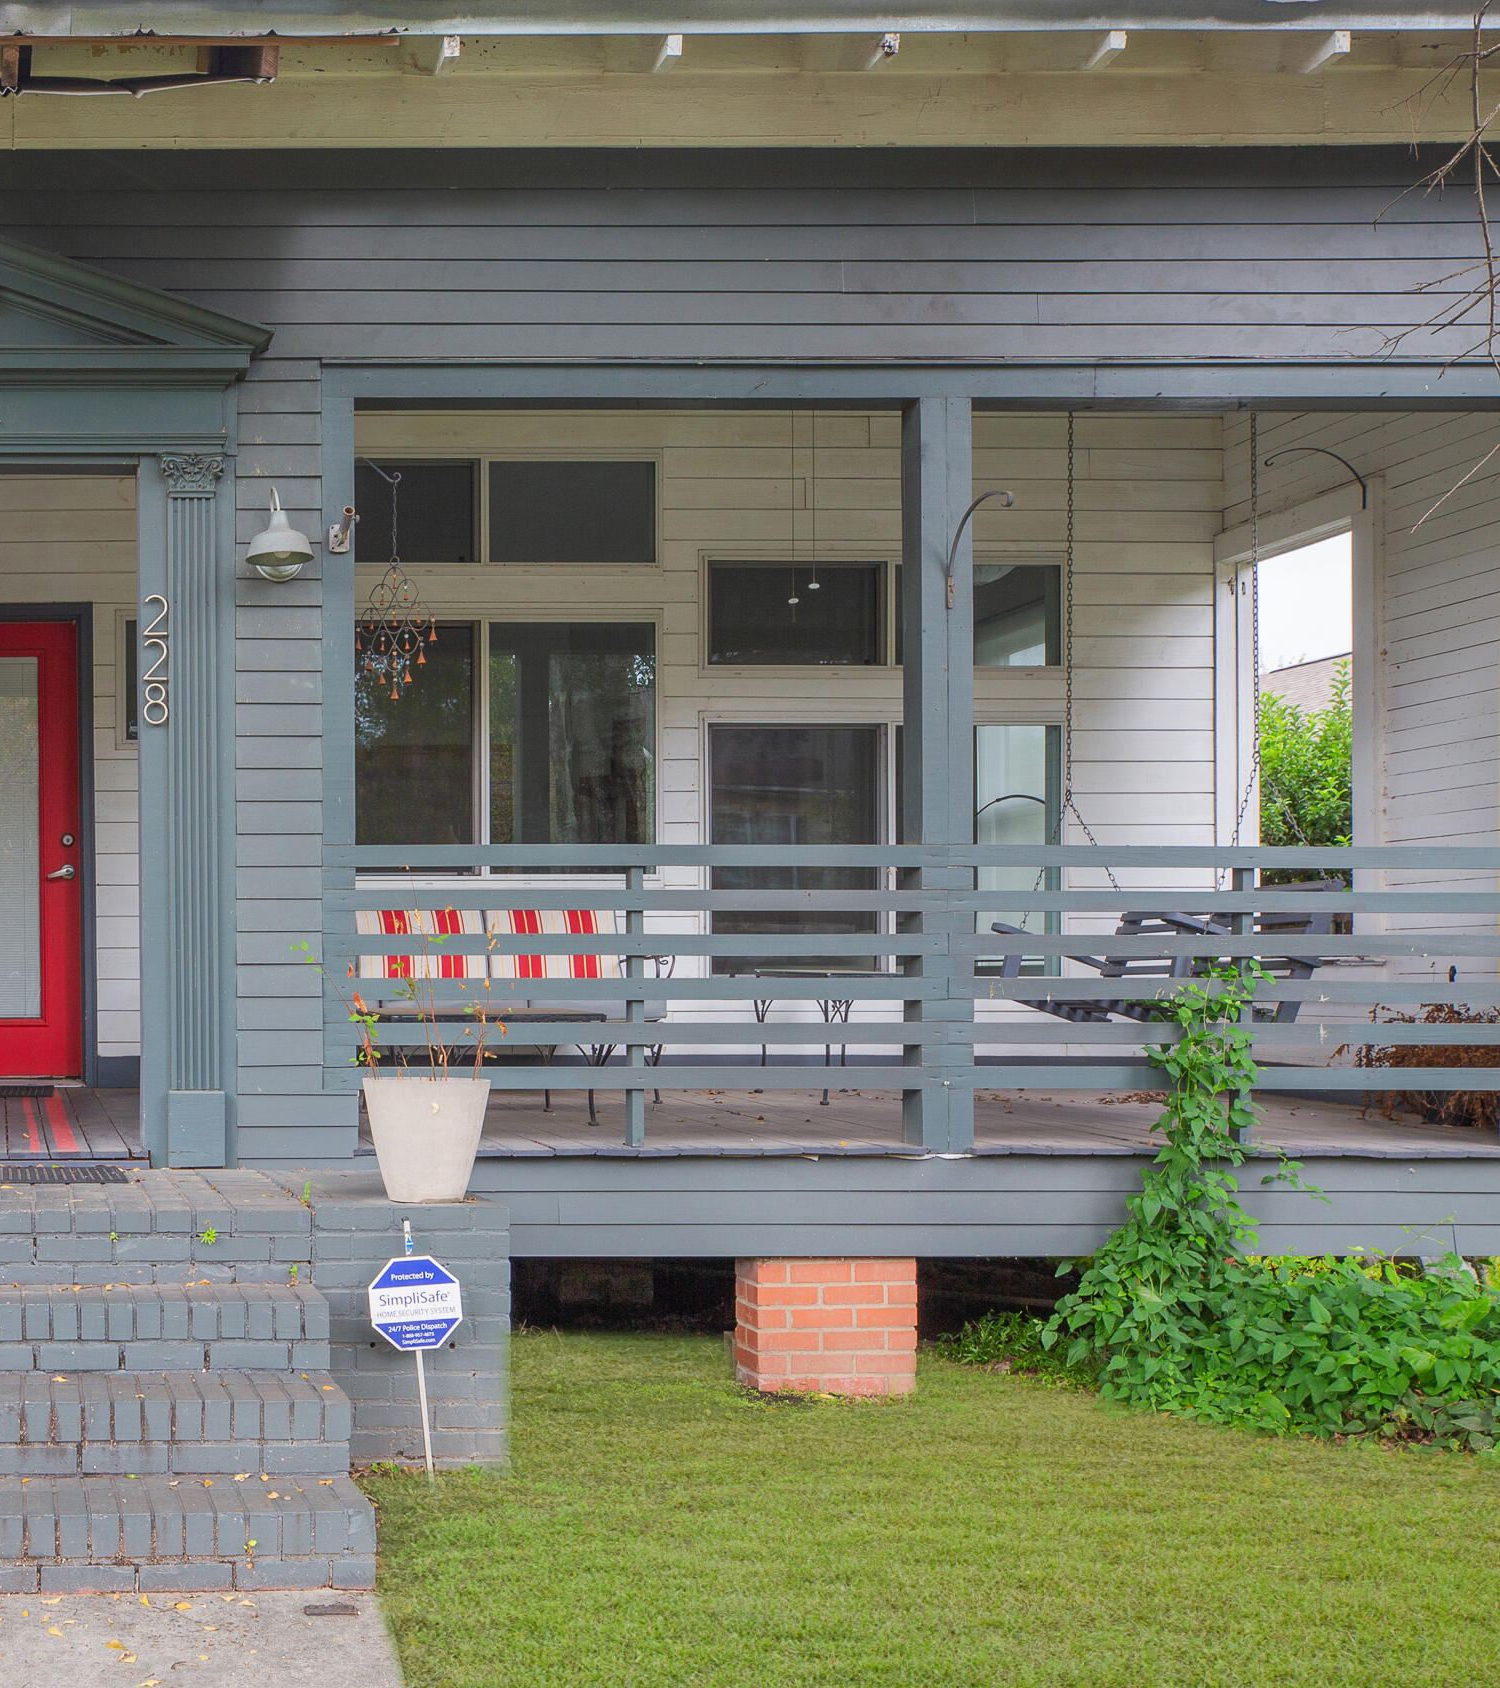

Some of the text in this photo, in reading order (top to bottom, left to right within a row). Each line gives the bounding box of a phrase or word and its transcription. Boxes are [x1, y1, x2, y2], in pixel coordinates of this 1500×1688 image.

[143, 594, 168, 725] 228
[390, 1271, 434, 1281] Protected by
[376, 1306, 456, 1319] HOME SECURITY SYSTEM
[388, 1322, 448, 1333] 24/7 Police Dispatch
